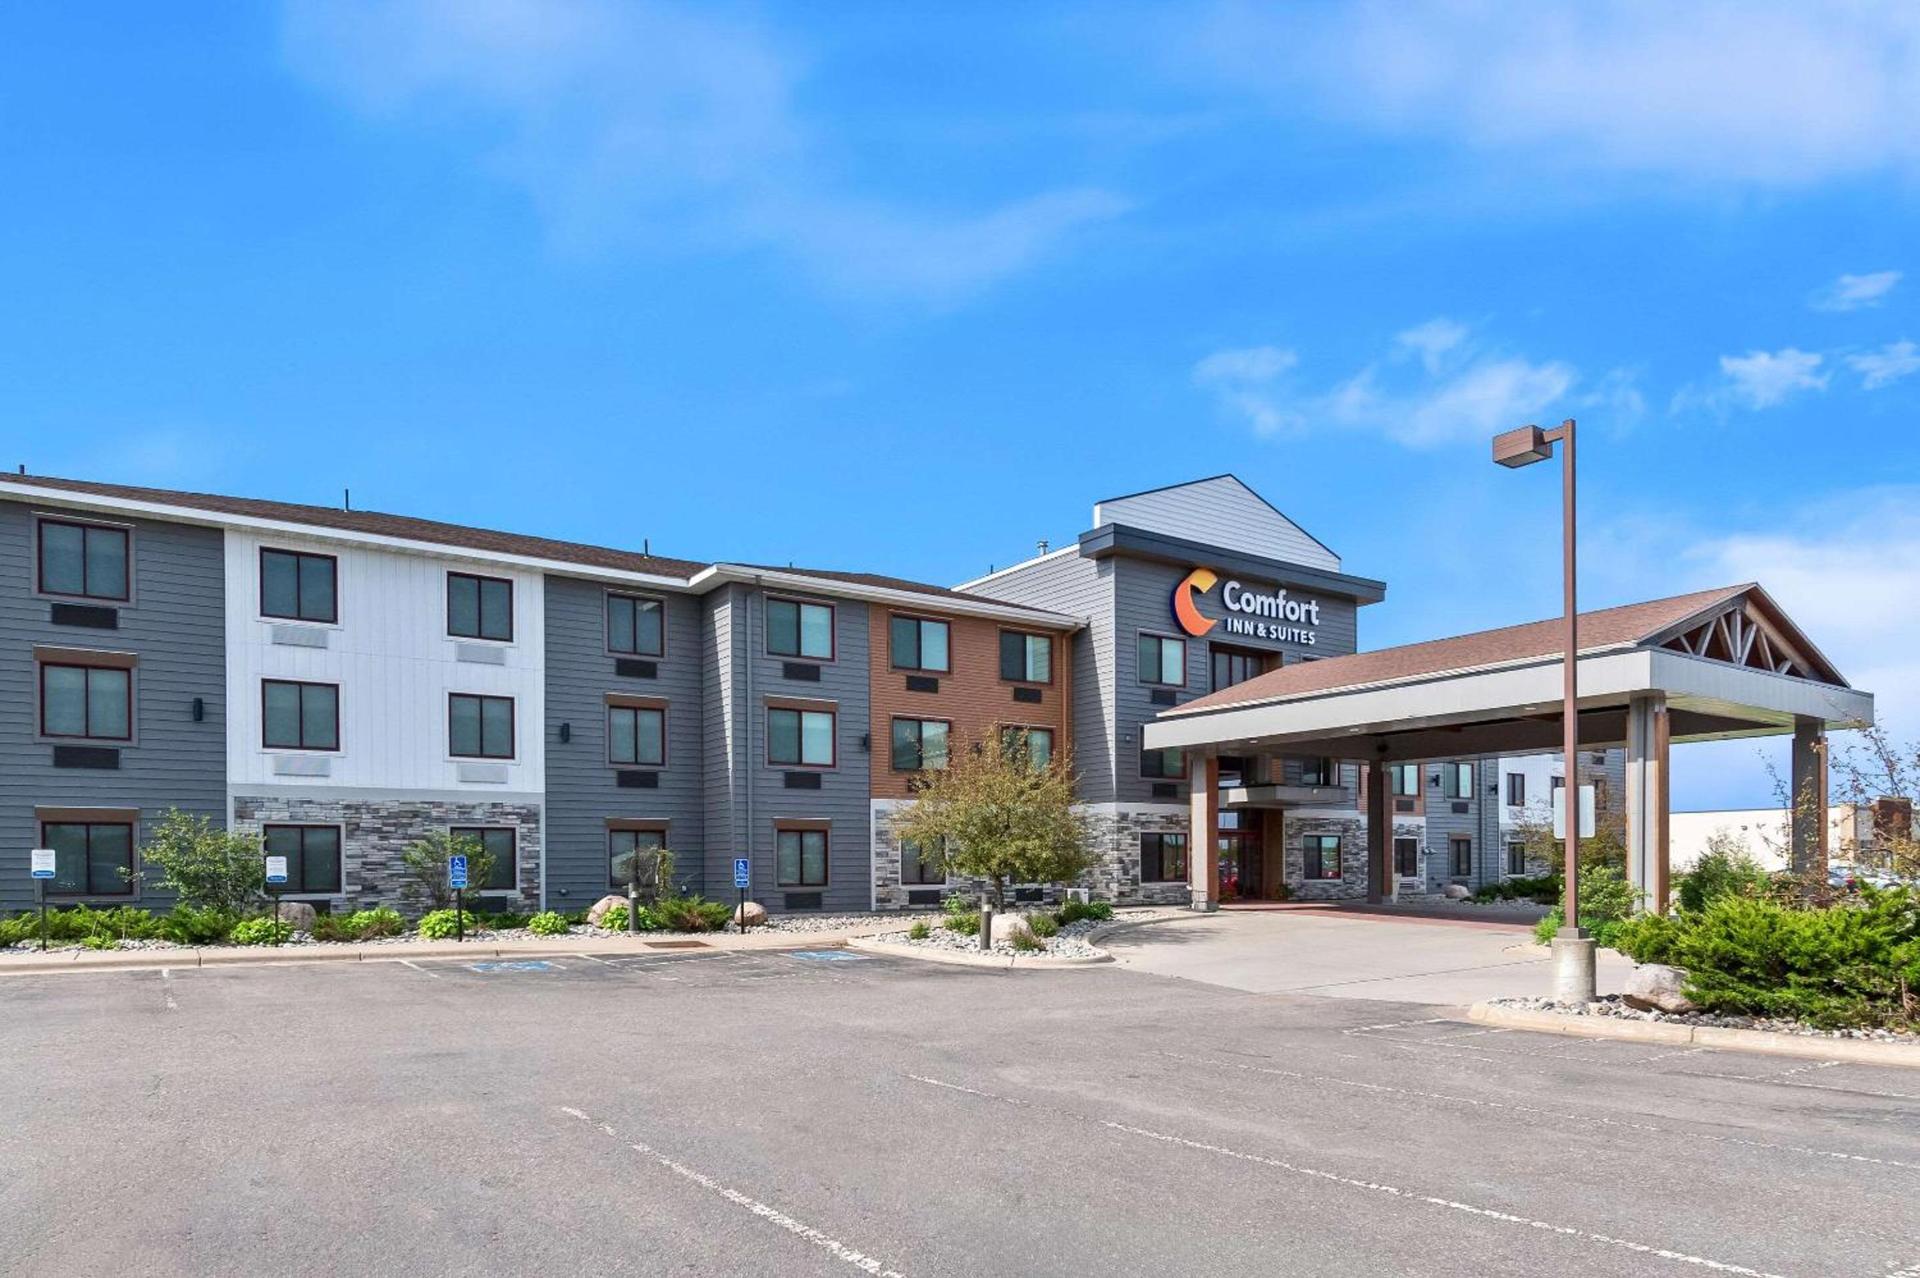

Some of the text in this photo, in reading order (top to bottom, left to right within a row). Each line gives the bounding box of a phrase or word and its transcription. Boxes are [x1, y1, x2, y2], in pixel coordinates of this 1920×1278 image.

[1223, 580, 1320, 626] Comfort
[1227, 617, 1316, 645] INN & SUITES
